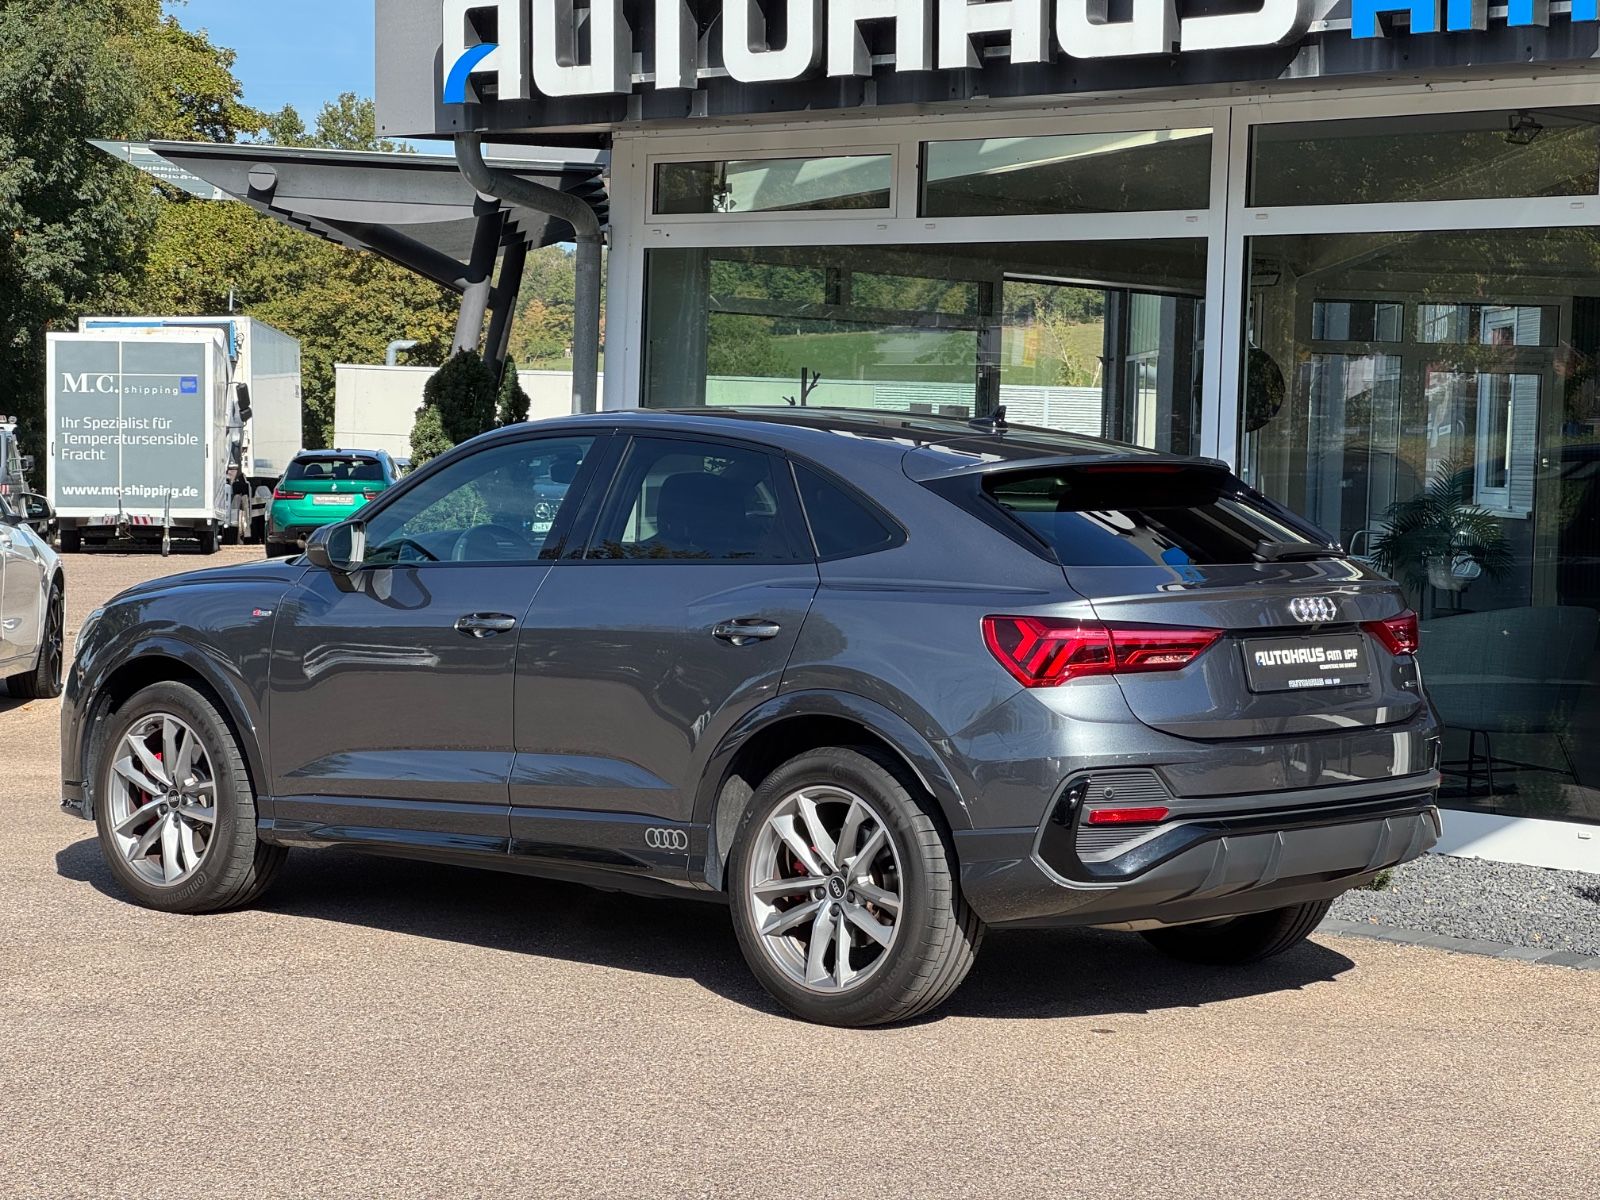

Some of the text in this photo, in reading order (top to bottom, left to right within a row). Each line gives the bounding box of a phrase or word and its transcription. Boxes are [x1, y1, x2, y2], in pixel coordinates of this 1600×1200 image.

[62, 372, 179, 396] M.C. shipping
[61, 416, 173, 431] Ihr Spezialist für
[62, 432, 199, 447] Temperatursensible
[61, 448, 107, 461] Fracht
[62, 484, 199, 499] www.mc-shipping.de
[1254, 647, 1326, 667] AUTOHAUS
